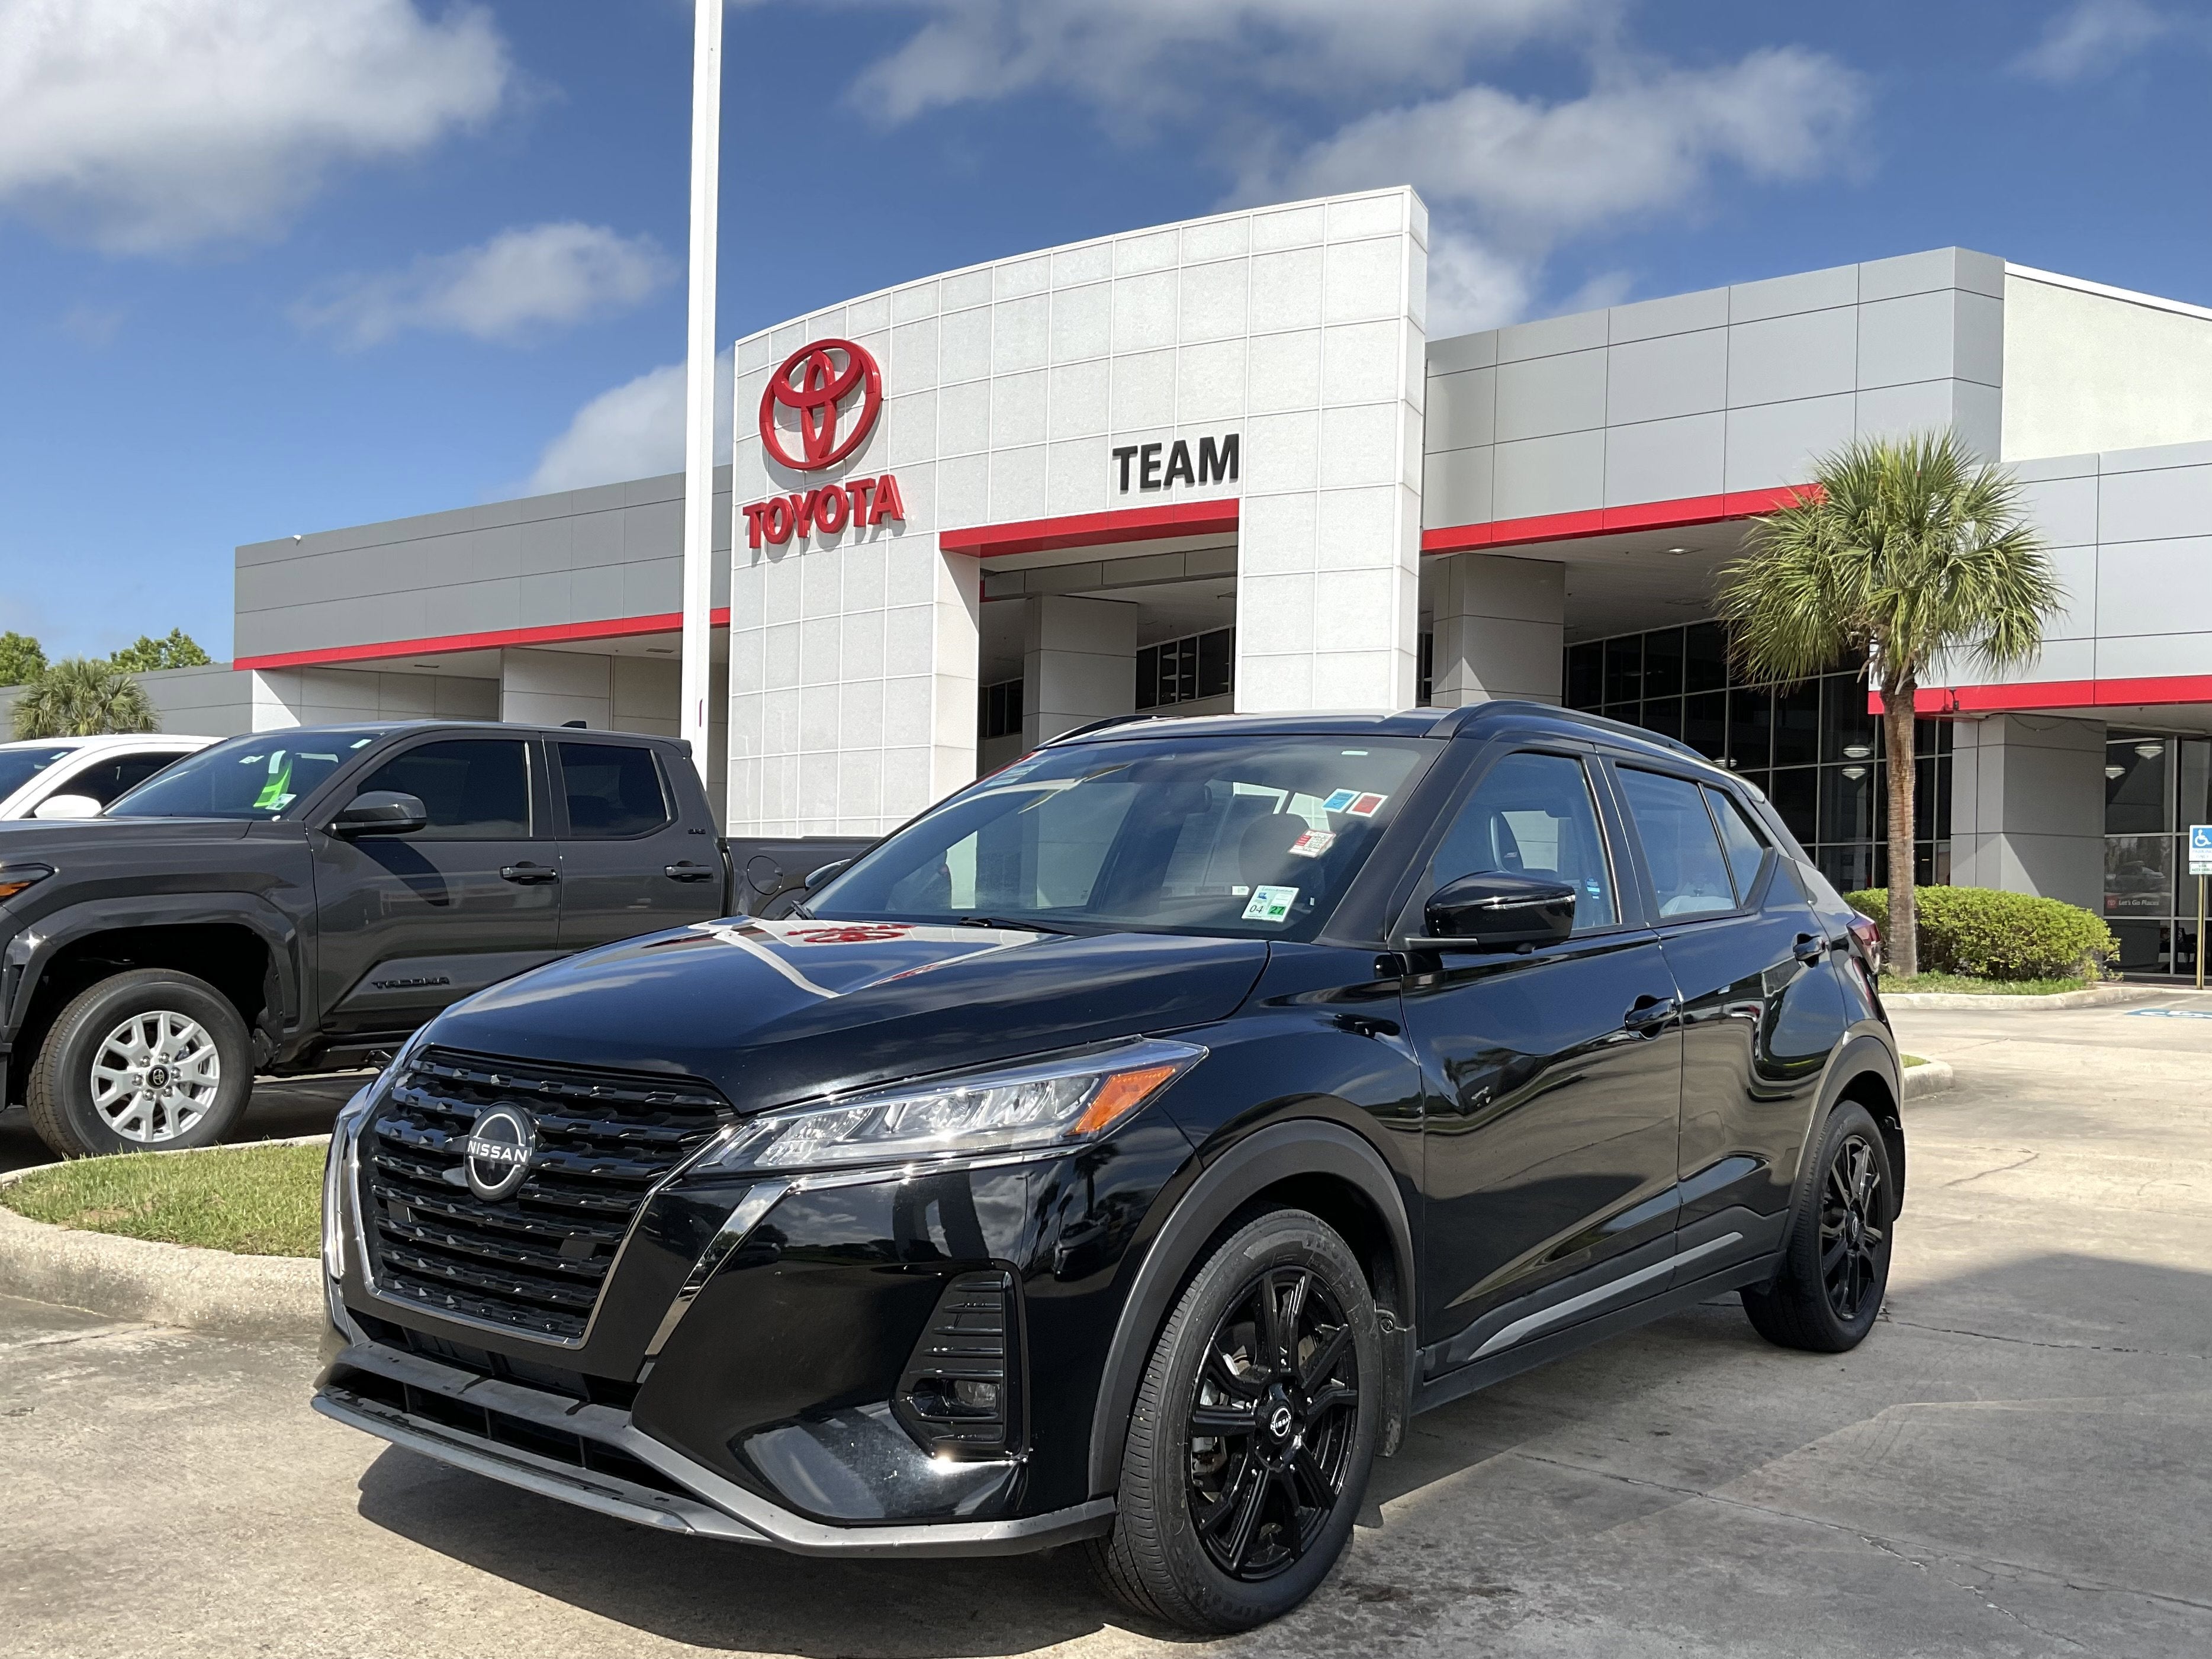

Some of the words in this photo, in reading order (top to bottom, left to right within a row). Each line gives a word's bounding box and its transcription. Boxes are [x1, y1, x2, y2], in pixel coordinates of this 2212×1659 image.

[1112, 433, 1239, 491] TEAM
[743, 474, 904, 548] TOYOTA
[1249, 905, 1264, 914] 04
[1269, 906, 1285, 914] 27
[467, 1140, 528, 1162] NISSAN
